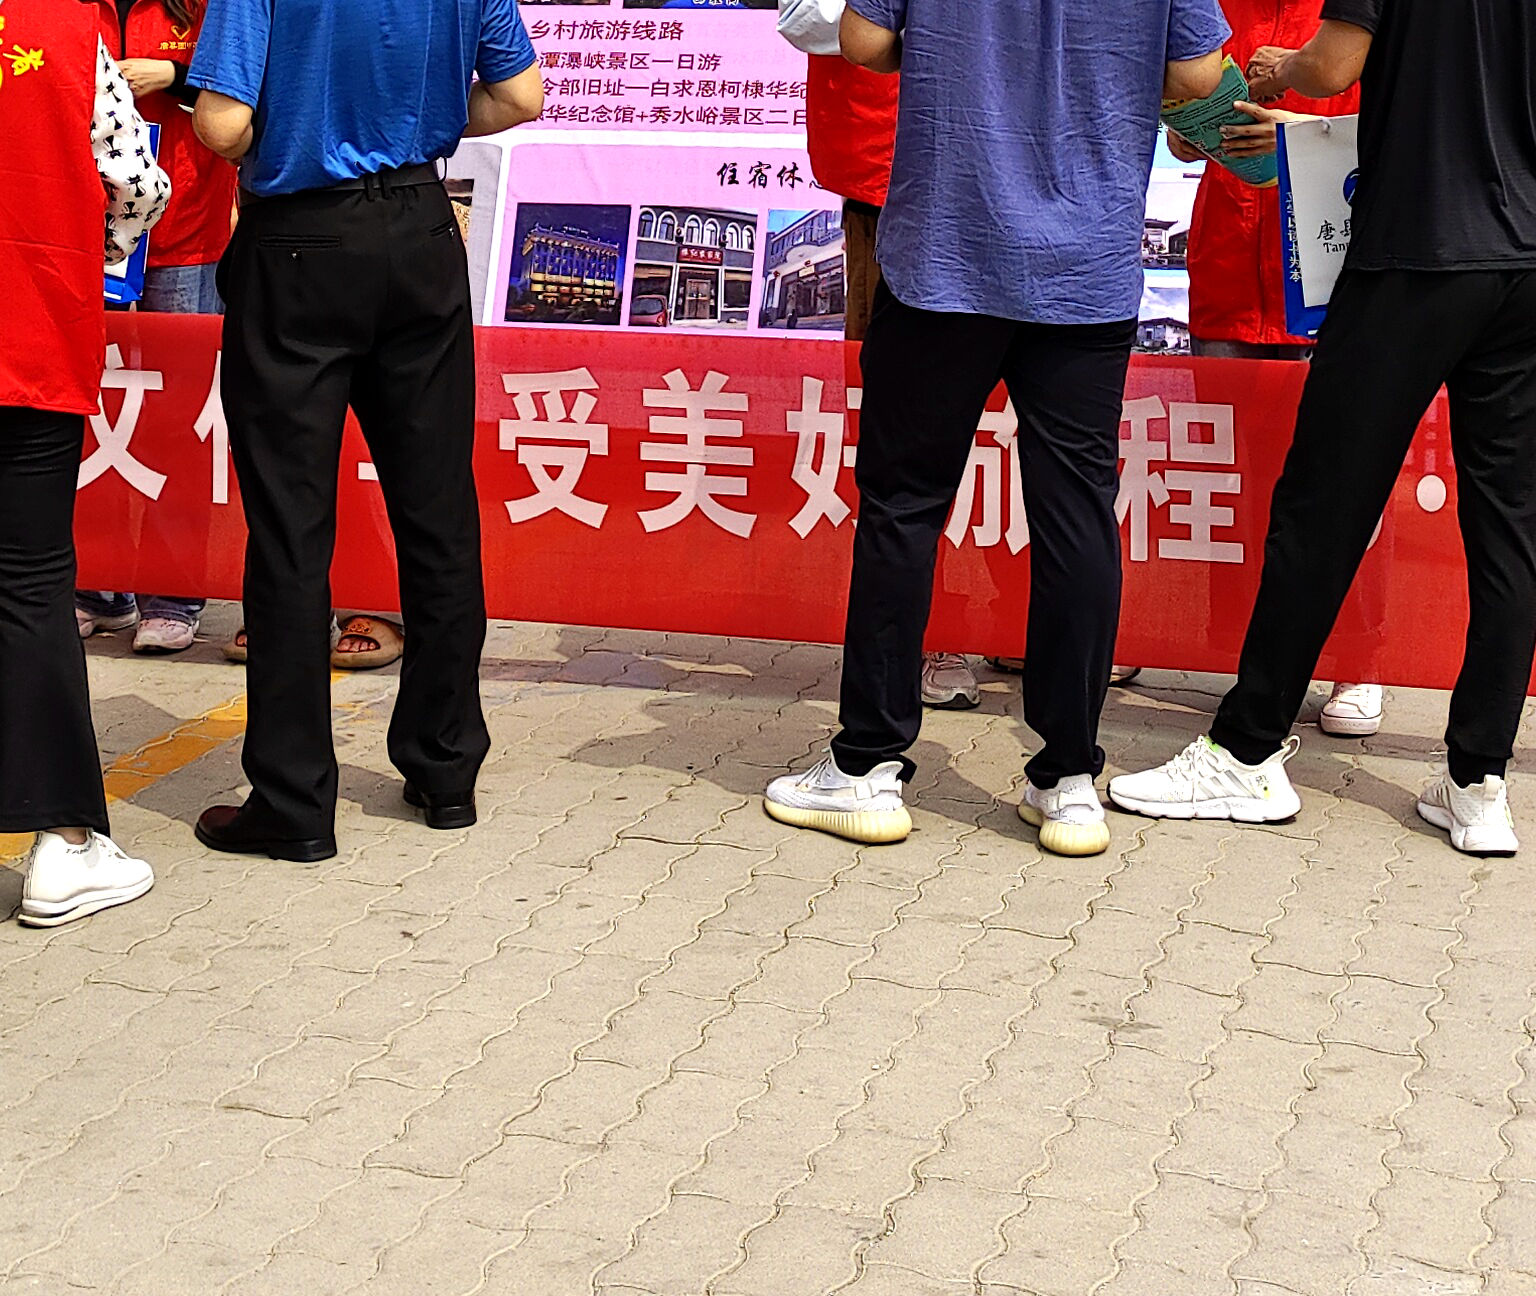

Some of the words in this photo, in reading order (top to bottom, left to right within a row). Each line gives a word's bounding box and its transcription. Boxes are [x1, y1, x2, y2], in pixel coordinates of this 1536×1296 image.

[530, 19, 685, 42] 乡村旅游线路
